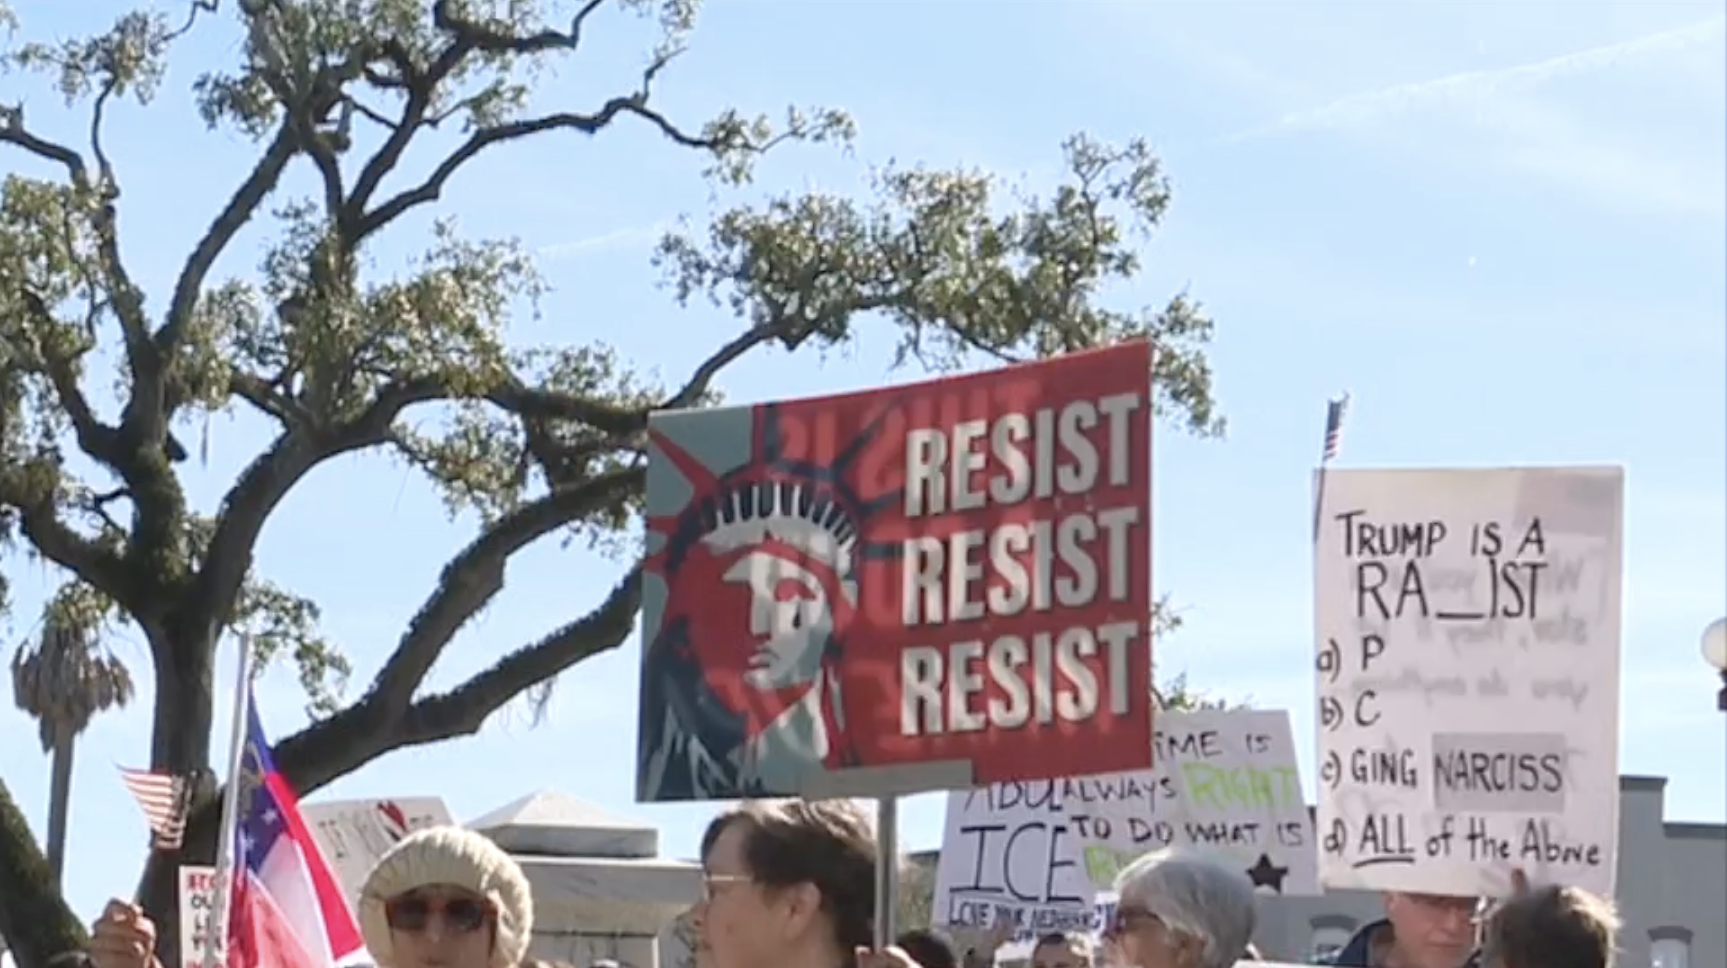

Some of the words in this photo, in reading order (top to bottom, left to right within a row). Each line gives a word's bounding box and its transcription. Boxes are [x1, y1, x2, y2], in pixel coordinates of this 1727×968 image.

[906, 391, 1139, 516] RESIST
[1335, 509, 1447, 557] TRUMP
[1471, 522, 1503, 557] IS
[1517, 515, 1546, 556] A
[902, 506, 1138, 627] RESIST
[900, 620, 1138, 737] RESIST
[1315, 637, 1341, 684] a)
[1361, 634, 1385, 671] P
[1320, 696, 1343, 733] b)
[1355, 689, 1381, 727] C
[1246, 733, 1272, 754] IS
[1063, 775, 1178, 815] ALWAYS
[1181, 762, 1297, 813] RIGHT
[1351, 749, 1417, 789] GING
[1433, 751, 1563, 793] NARCISS
[1070, 813, 1113, 840] TO
[1126, 816, 1174, 848] DO
[1184, 820, 1260, 847] WHAT
[1276, 822, 1303, 847] IS
[1358, 812, 1416, 856] ALL
[1426, 815, 1455, 857] of
[1466, 815, 1511, 862] the
[949, 821, 1085, 905] ICE
